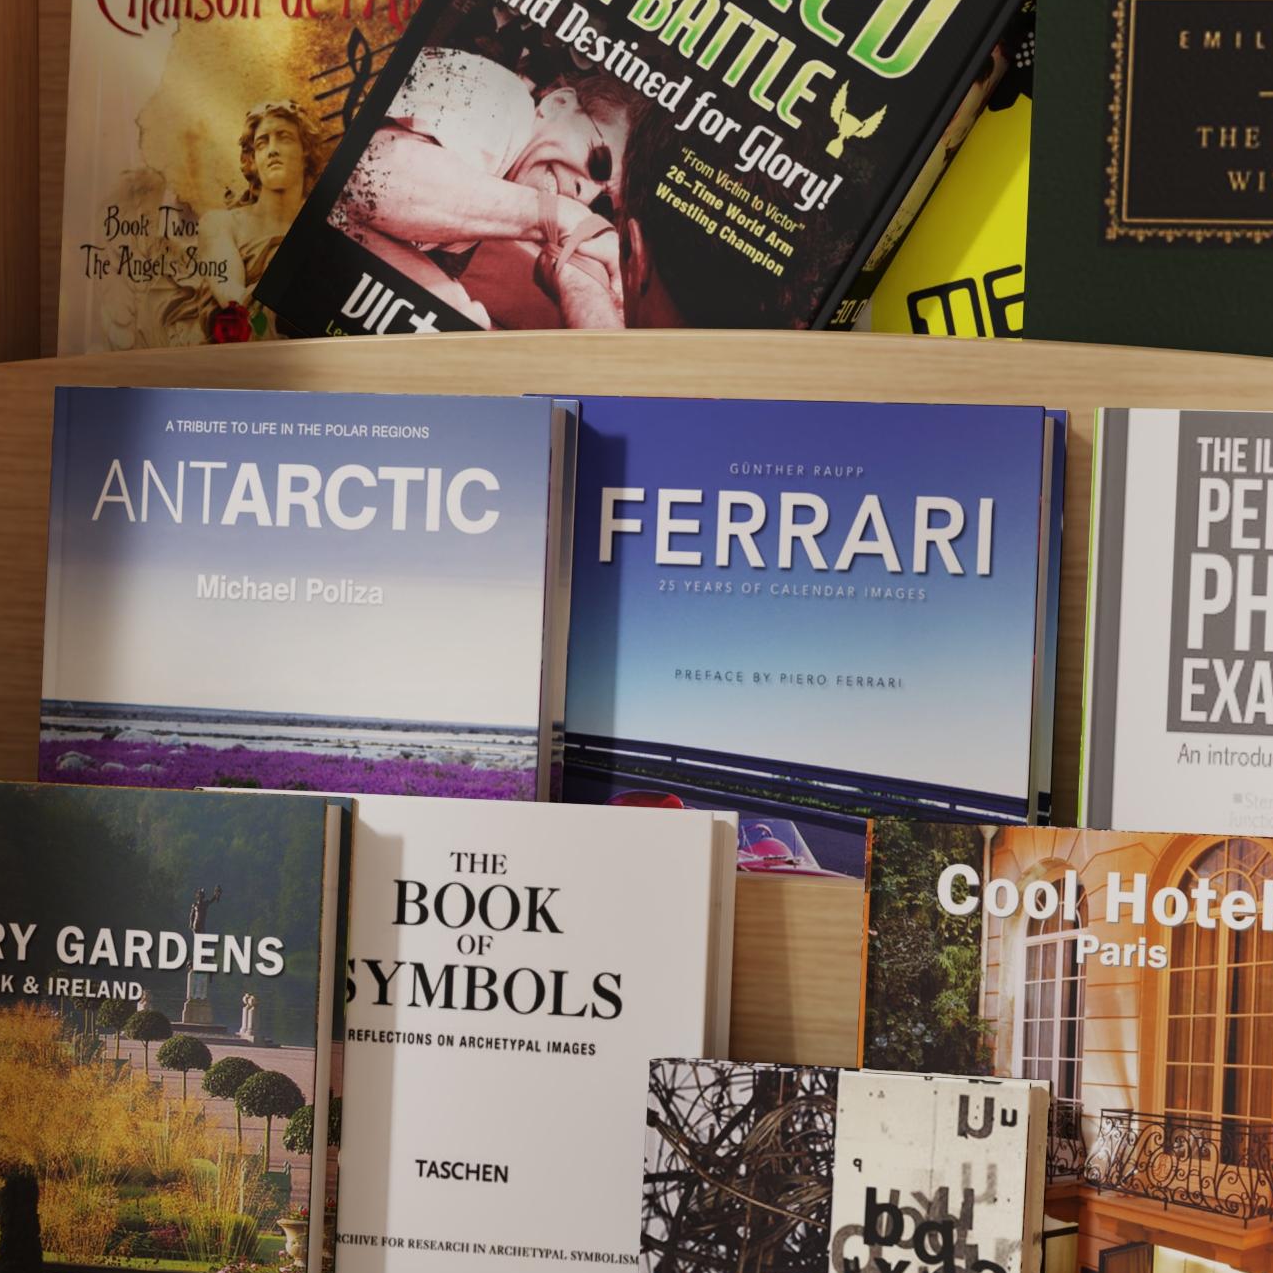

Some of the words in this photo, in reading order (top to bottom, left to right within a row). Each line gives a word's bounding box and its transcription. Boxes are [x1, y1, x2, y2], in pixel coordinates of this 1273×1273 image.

[555, 2, 693, 110] Destined
[674, 92, 747, 144] for
[734, 125, 844, 212] Glory!
[1196, 126, 1260, 149] THE
[716, 170, 750, 203] Victim
[751, 194, 764, 212] to
[104, 205, 149, 242] Book
[159, 205, 199, 240] Two:
[655, 182, 718, 235] Wrestling
[719, 225, 784, 277] Champion
[725, 203, 766, 238] World
[765, 230, 794, 258] Arm
[80, 244, 111, 279] The
[117, 244, 177, 283] Angel's
[178, 245, 228, 283] Song
[165, 421, 174, 432] A
[176, 420, 228, 434] TRIBUTE
[231, 421, 248, 434] TO
[251, 422, 277, 435] LIFE
[280, 423, 293, 435] IN
[297, 423, 322, 437] THE
[325, 424, 368, 438] POLAR
[372, 424, 429, 439] REGIONS
[1197, 436, 1248, 473] THE
[813, 466, 865, 478] RAUPP
[91, 458, 501, 535] ANTARCTIC
[598, 486, 995, 576] FERRARI
[196, 574, 296, 603] Michael
[305, 578, 384, 605] Poliza
[658, 579, 676, 591] 25
[684, 581, 732, 594] YEARS
[741, 582, 762, 595] OF
[770, 583, 856, 598] CALENDAR
[863, 587, 928, 600] IMAGES
[675, 669, 744, 683] PREFACE
[753, 672, 771, 684] BY
[780, 673, 827, 686] PIERO
[836, 675, 903, 688] FERRARI
[1177, 743, 1201, 765] An
[450, 851, 507, 875] THE
[392, 879, 564, 934] BOOK
[937, 862, 1078, 922] Cool
[56, 925, 286, 977] GARDENS
[456, 933, 494, 957] OF
[1075, 933, 1169, 970] Paris
[23, 976, 39, 995] &
[47, 977, 143, 1000] IRELAND
[348, 1029, 432, 1046] REFLECTIONS
[438, 1035, 454, 1047] ON
[459, 1036, 542, 1053] ARCHETYPAL
[547, 1041, 596, 1056] IMAGES
[415, 1158, 508, 1184] TASCHEN
[381, 1236, 404, 1248] FOR
[408, 1238, 469, 1253] RESEARCH
[473, 1243, 485, 1254] IN
[489, 1244, 567, 1260] ARCHETYPAL
